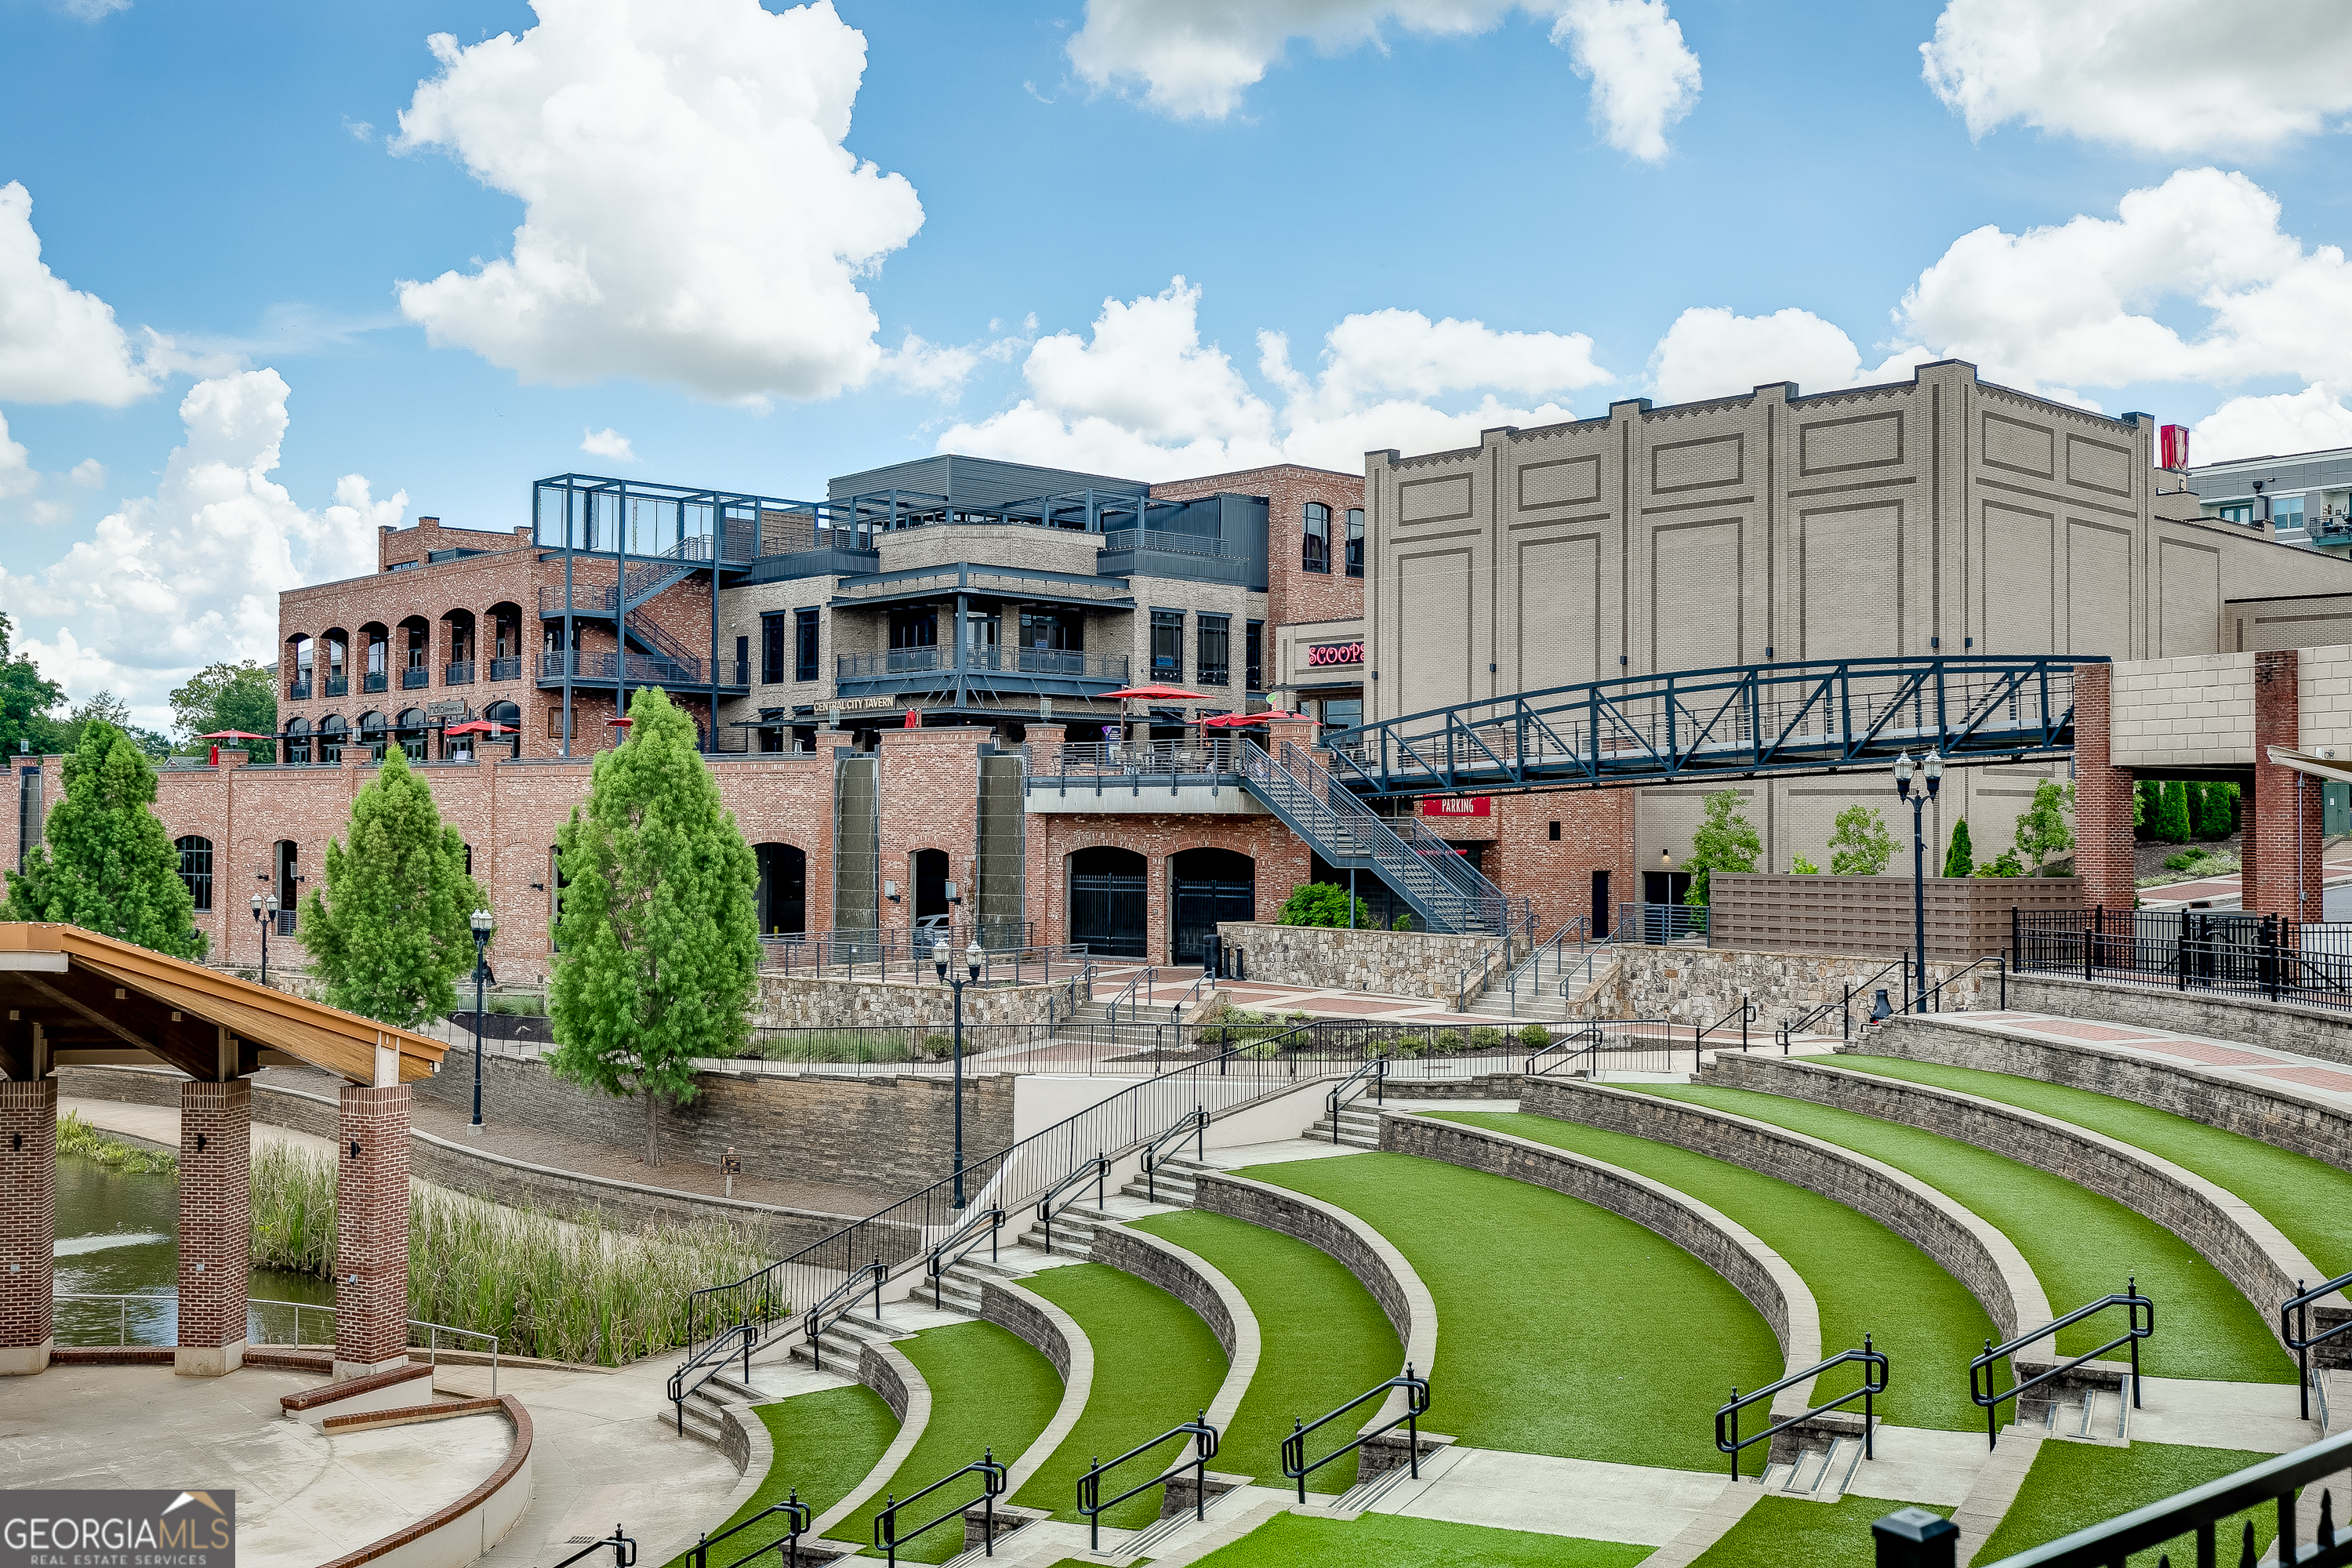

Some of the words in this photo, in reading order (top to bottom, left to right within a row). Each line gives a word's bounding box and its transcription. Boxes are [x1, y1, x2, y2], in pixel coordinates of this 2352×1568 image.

[814, 700, 846, 712] CENTRAL
[847, 699, 863, 710] CITY
[864, 696, 894, 709] TAVERN
[1442, 798, 1474, 813] PARKING
